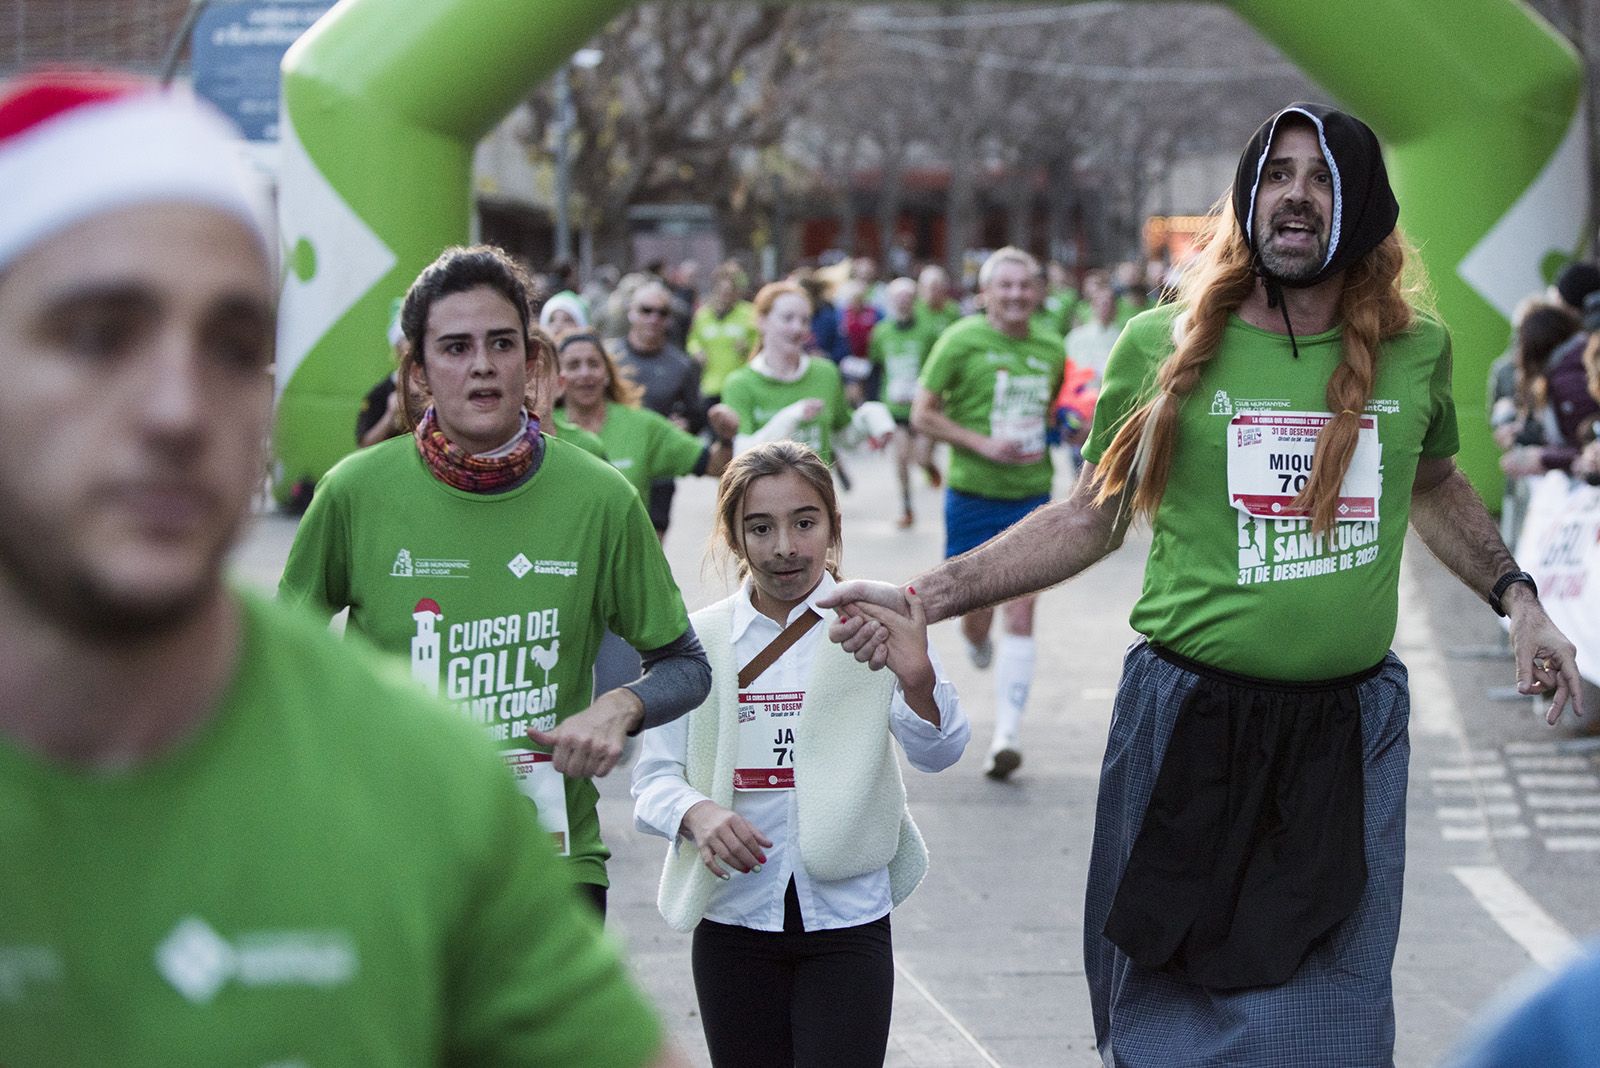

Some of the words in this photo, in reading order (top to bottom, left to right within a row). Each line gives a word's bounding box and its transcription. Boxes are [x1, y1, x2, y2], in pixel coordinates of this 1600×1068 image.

[1272, 427, 1279, 435] 31
[1280, 428, 1288, 436] DE
[1273, 531, 1325, 562] SANT
[1237, 568, 1251, 585] 31
[1254, 566, 1270, 584] DE
[1273, 556, 1337, 582] DESEMBRE
[1339, 553, 1353, 571] DE
[1355, 545, 1380, 567] 2023
[449, 614, 521, 654] CURSA
[526, 608, 560, 642] DEL
[447, 647, 532, 700] GALL
[500, 683, 559, 720] CUGAT
[764, 704, 771, 712] 31
[772, 703, 780, 711] DE
[511, 720, 528, 738] DE
[774, 728, 795, 745] JA
